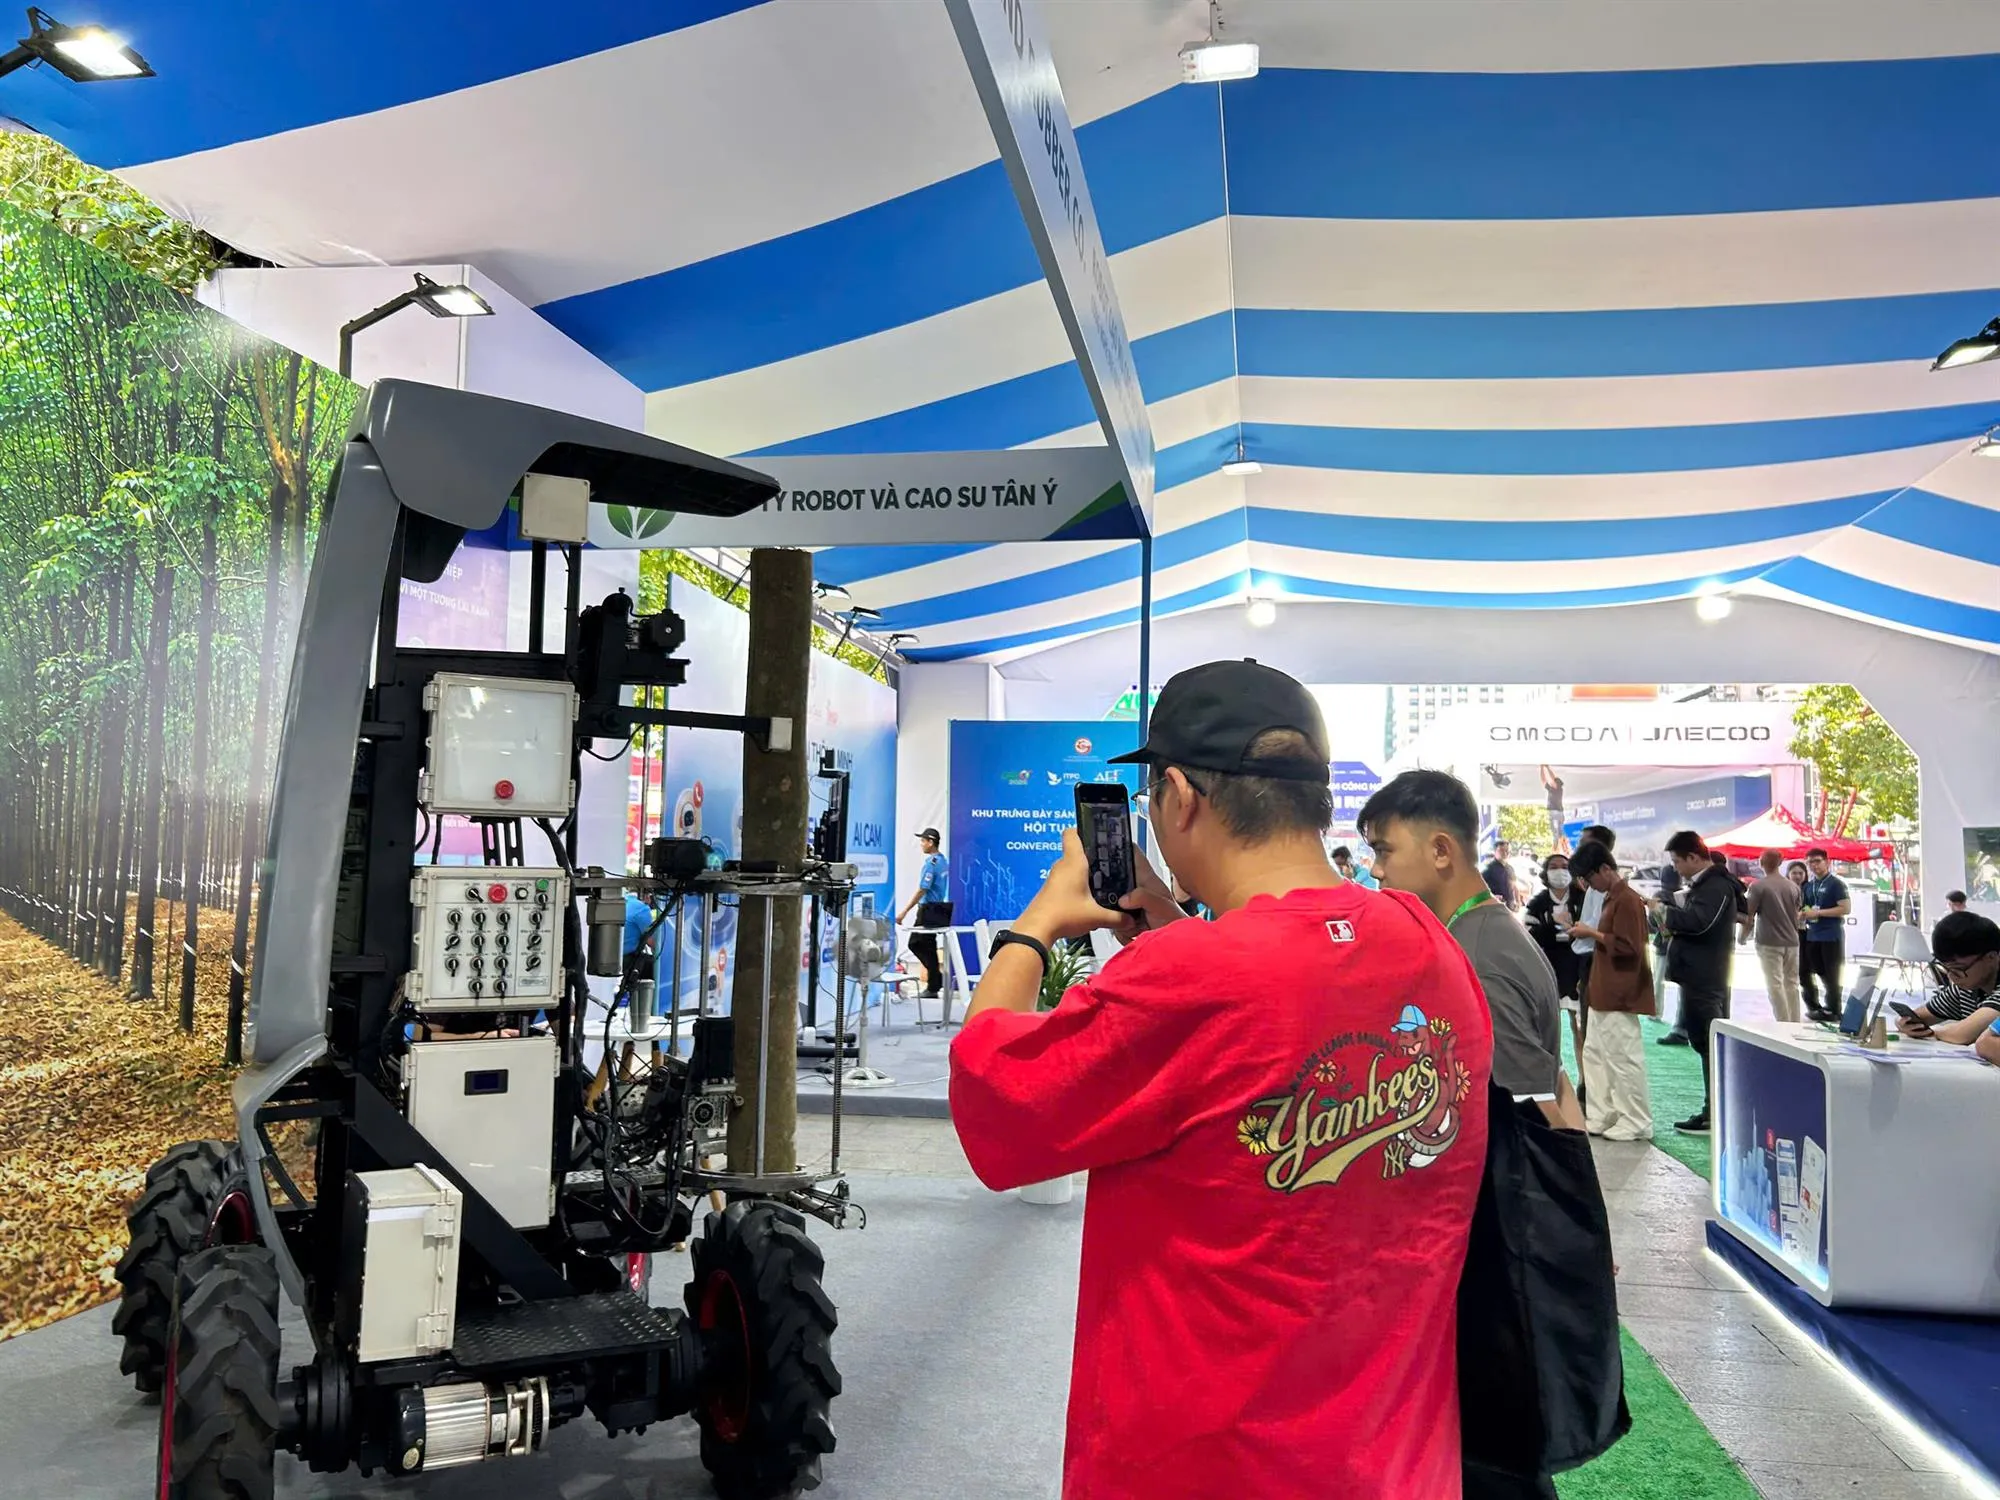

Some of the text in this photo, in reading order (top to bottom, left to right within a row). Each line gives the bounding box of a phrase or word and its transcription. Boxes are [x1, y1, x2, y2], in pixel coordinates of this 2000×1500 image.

[791, 489, 866, 512] ROBOT
[870, 482, 900, 510] VÀ
[904, 486, 952, 509] CAO
[957, 485, 987, 508] SU
[991, 478, 1036, 507] TÂN
[1042, 477, 1059, 506] Ý
[1489, 726, 1772, 742] OMODA JAECOO
[971, 808, 994, 818] KHU
[995, 807, 1030, 818] TRƯNG
[1032, 807, 1052, 819] BÀY
[853, 821, 882, 848] AI CAM
[1023, 821, 1047, 835] HỘI
[1006, 841, 1064, 851] CONVERGE
[1251, 1052, 1438, 1194] Yankees
